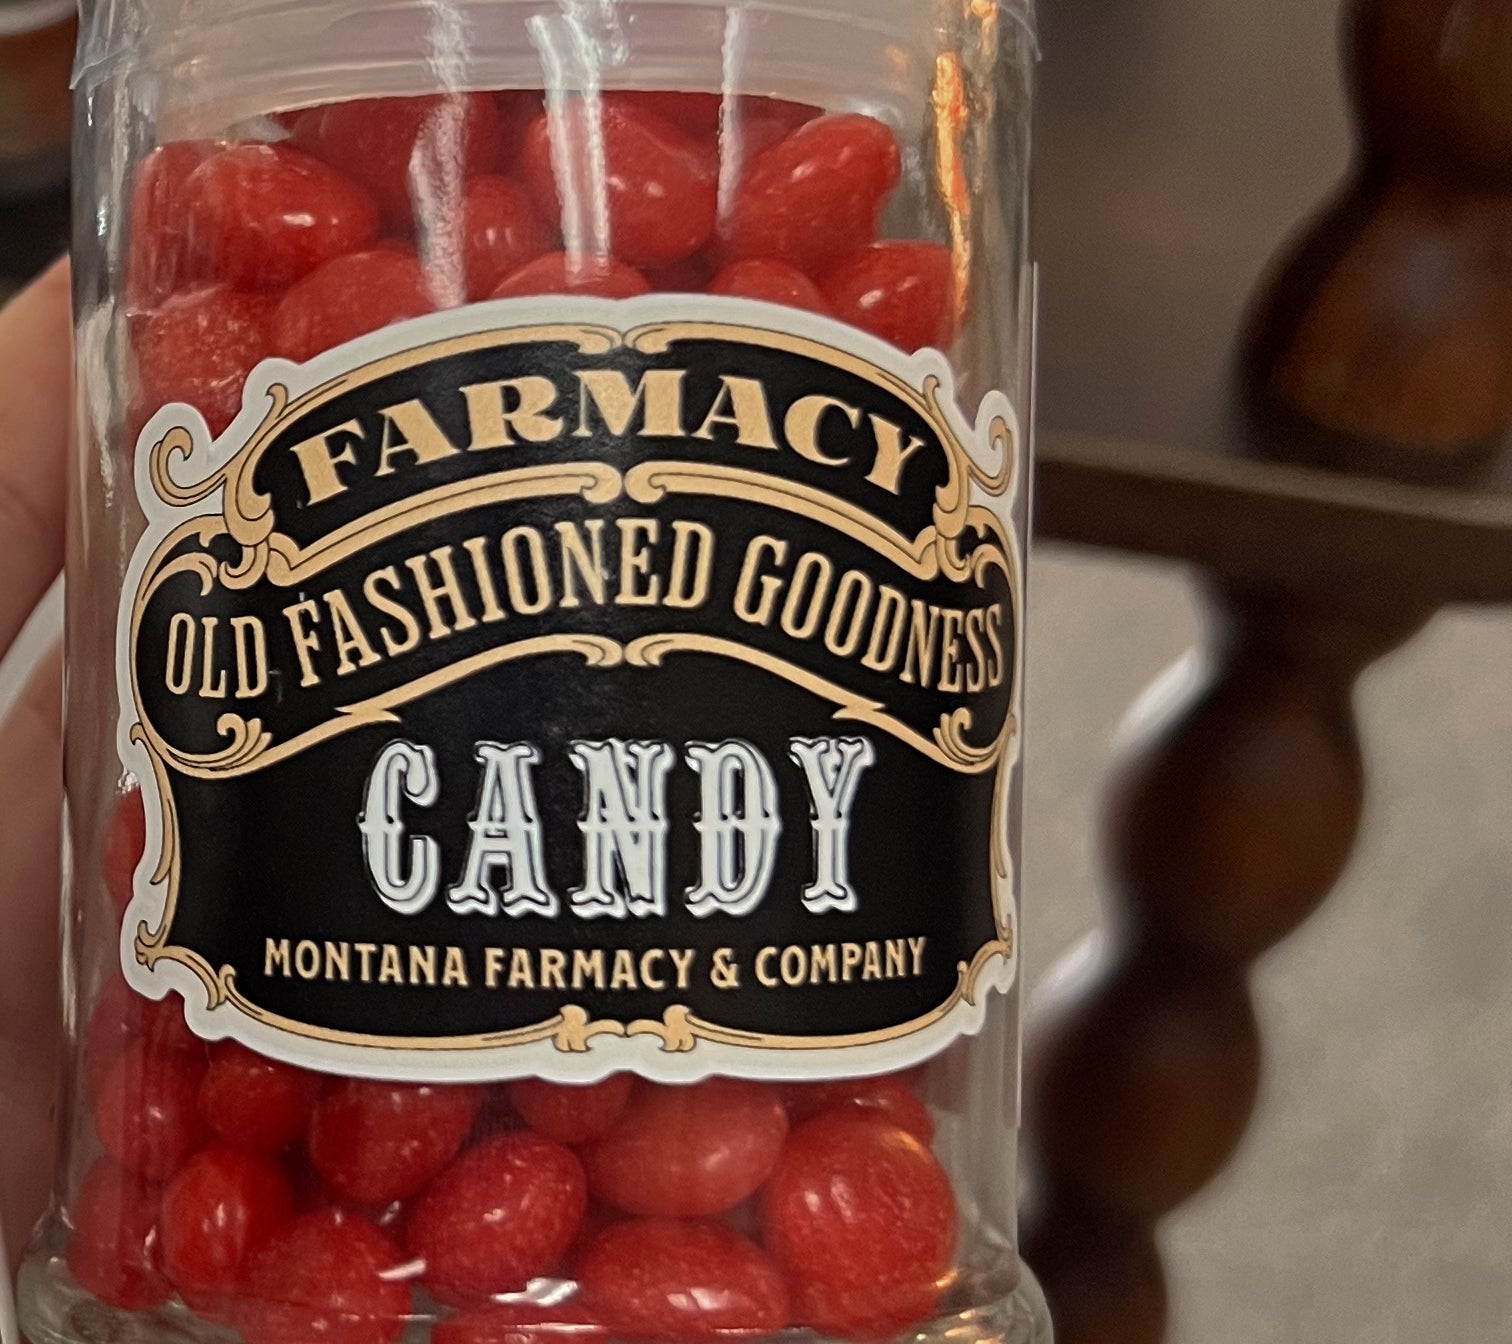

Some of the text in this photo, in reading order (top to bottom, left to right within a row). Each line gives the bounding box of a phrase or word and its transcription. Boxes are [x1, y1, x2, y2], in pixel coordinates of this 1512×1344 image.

[290, 369, 925, 506] FARMACY
[165, 518, 1003, 699] OLD FASHIONED GOODNESS
[358, 736, 876, 918] CANDY
[264, 937, 926, 990] MONTANA FARMACY & COMPANY
